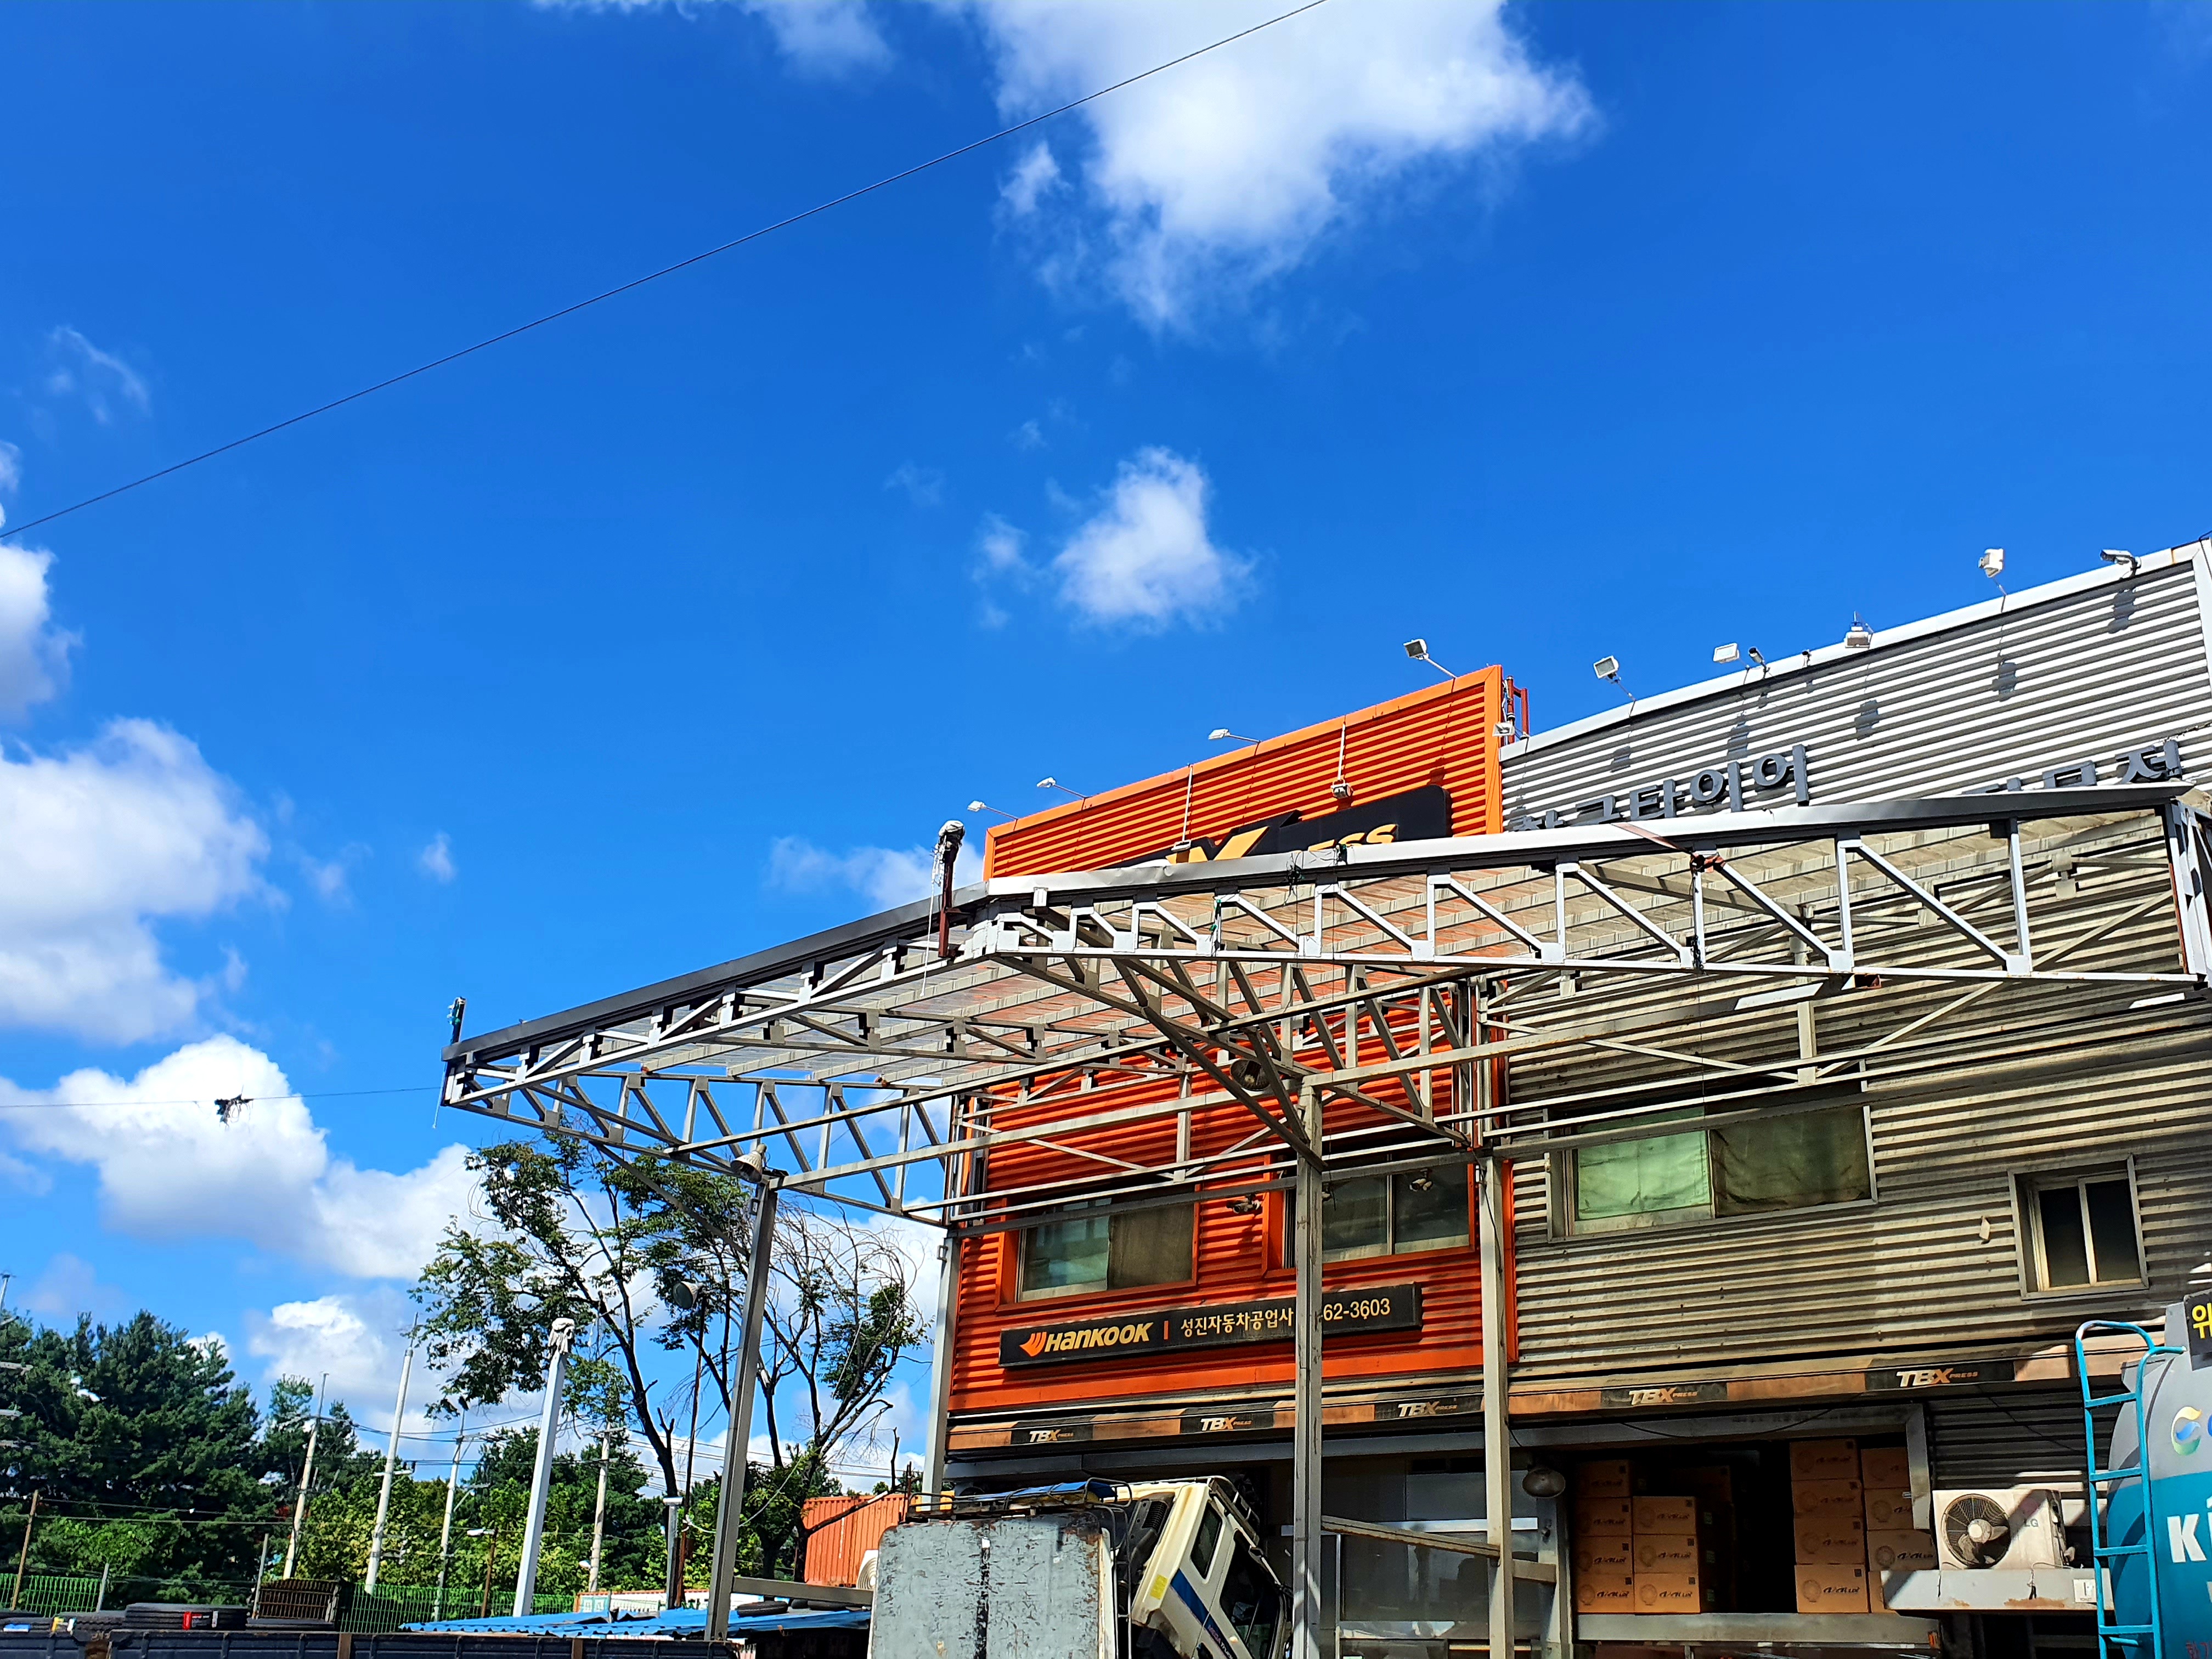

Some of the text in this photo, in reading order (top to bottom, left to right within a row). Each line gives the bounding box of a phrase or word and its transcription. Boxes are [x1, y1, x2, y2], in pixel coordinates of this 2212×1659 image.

[1181, 1307, 1294, 1338] 성진자동차공업사
[1322, 1298, 1391, 1322] 62-3603
[2023, 1519, 2039, 1527] LG
